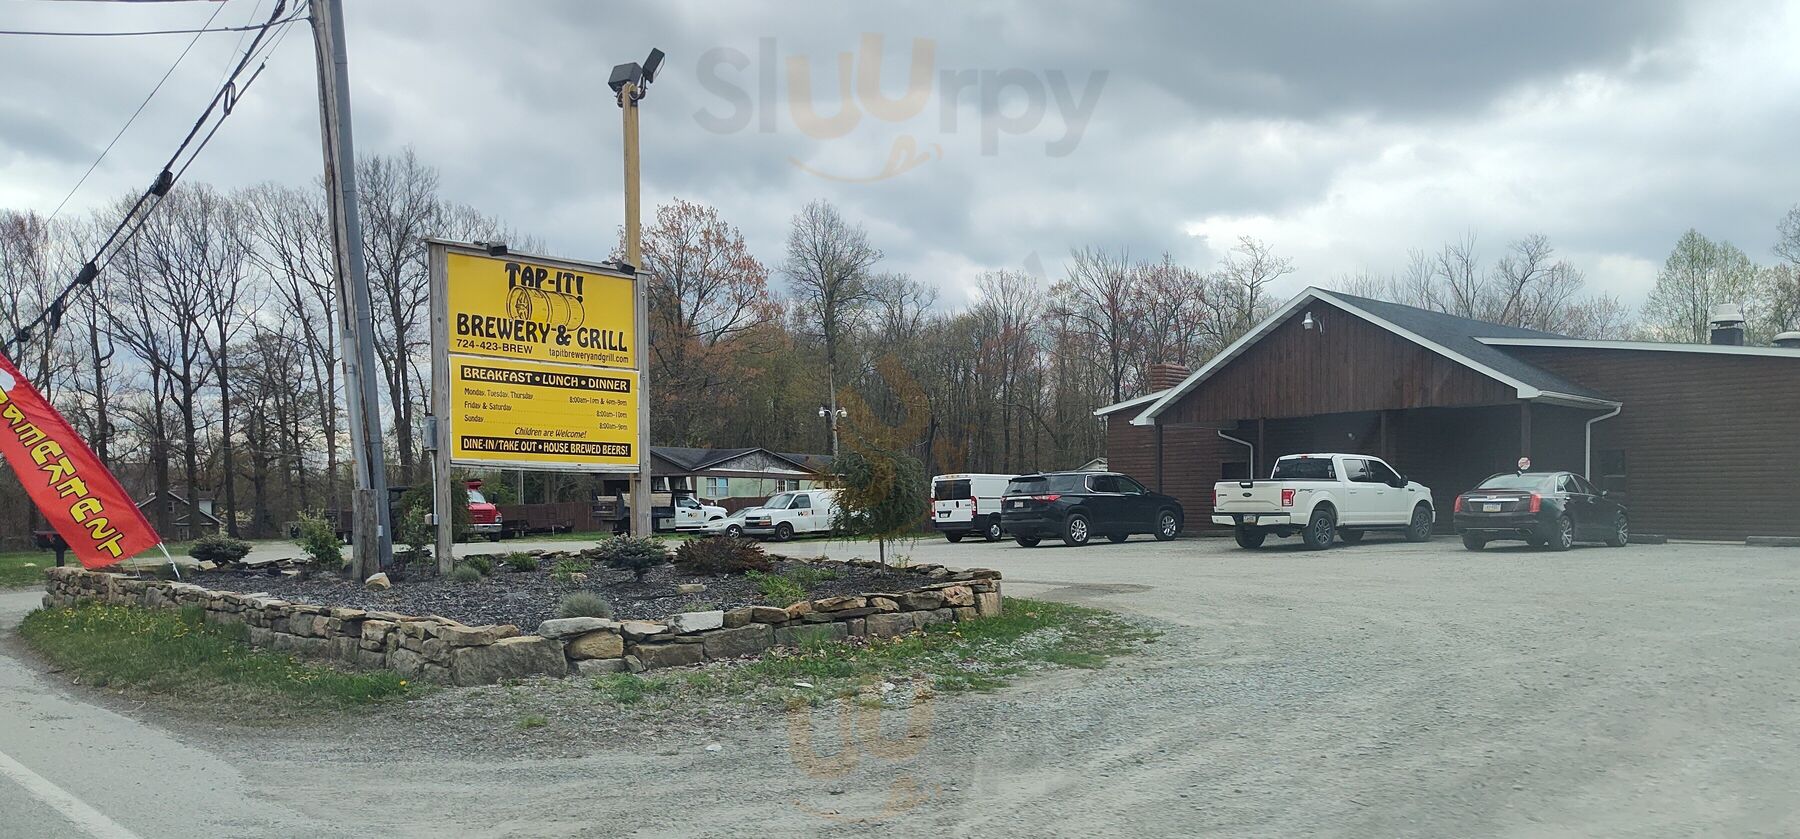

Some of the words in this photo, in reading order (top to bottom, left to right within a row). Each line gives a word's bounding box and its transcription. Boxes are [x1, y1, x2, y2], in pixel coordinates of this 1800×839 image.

[505, 262, 584, 304] TAP-IT!
[456, 313, 551, 344] BREWERY
[555, 324, 571, 346] &
[577, 327, 628, 352] GRILL
[456, 338, 533, 354] 724-423-BREW
[549, 348, 629, 363] tapitbreweryandgrill.com
[463, 367, 534, 383] BREAKFAST
[542, 374, 579, 387] LUNCH
[588, 378, 627, 391] DINNER
[510, 391, 534, 400] Thursday
[600, 397, 605, 405] &
[464, 400, 481, 409] Friday
[482, 401, 487, 410] &
[489, 402, 512, 411] Saturday
[464, 414, 485, 423] Sunday
[514, 426, 542, 437] Children
[543, 429, 554, 437] are
[555, 429, 587, 439] Welcome!
[463, 438, 519, 451] DINE-IN/TAKE
[520, 441, 538, 452] OUT
[543, 442, 569, 453] HOUSE
[570, 443, 601, 455] BREWED
[602, 445, 629, 456] BEERS!
